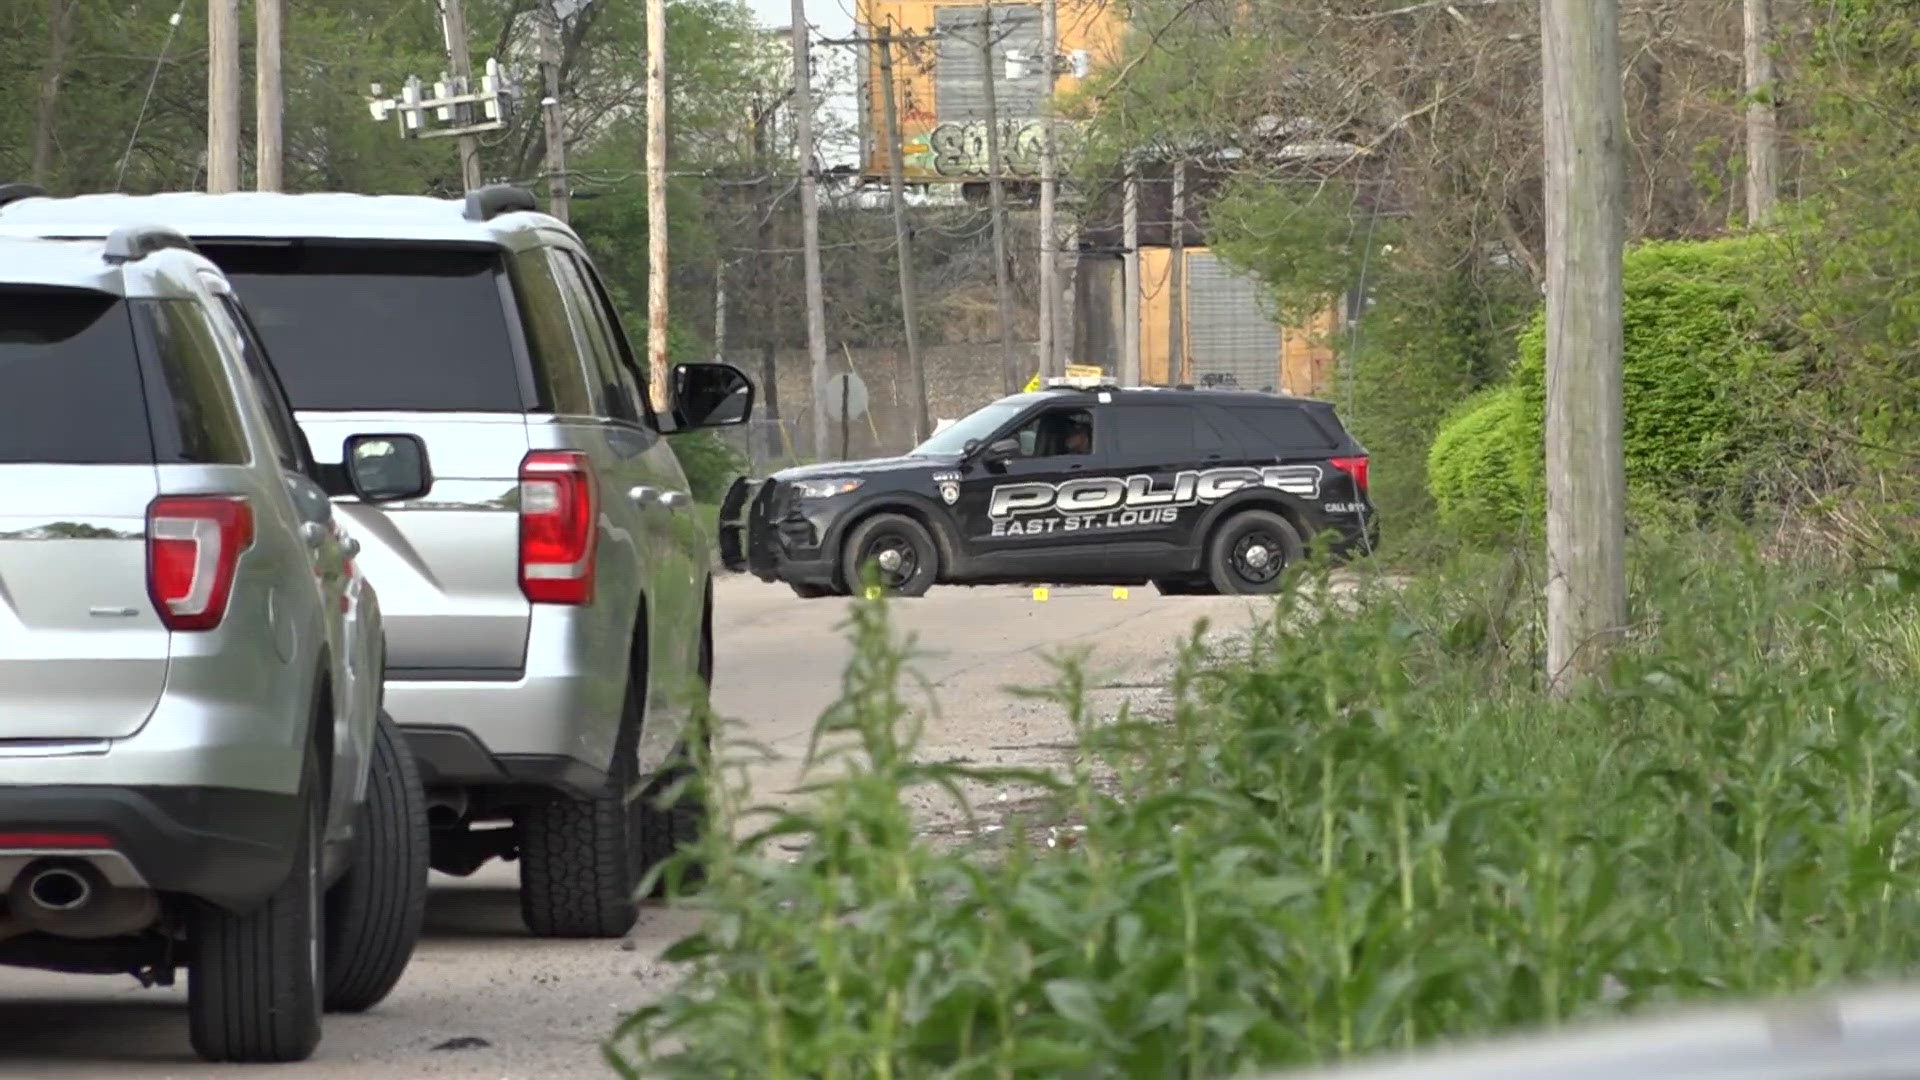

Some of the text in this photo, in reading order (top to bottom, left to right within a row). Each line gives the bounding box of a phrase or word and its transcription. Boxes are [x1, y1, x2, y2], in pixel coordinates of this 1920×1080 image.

[988, 465, 1322, 520] POLICE
[1324, 503, 1347, 512] CALL
[991, 507, 1179, 537] EAST ST. LOUIS
